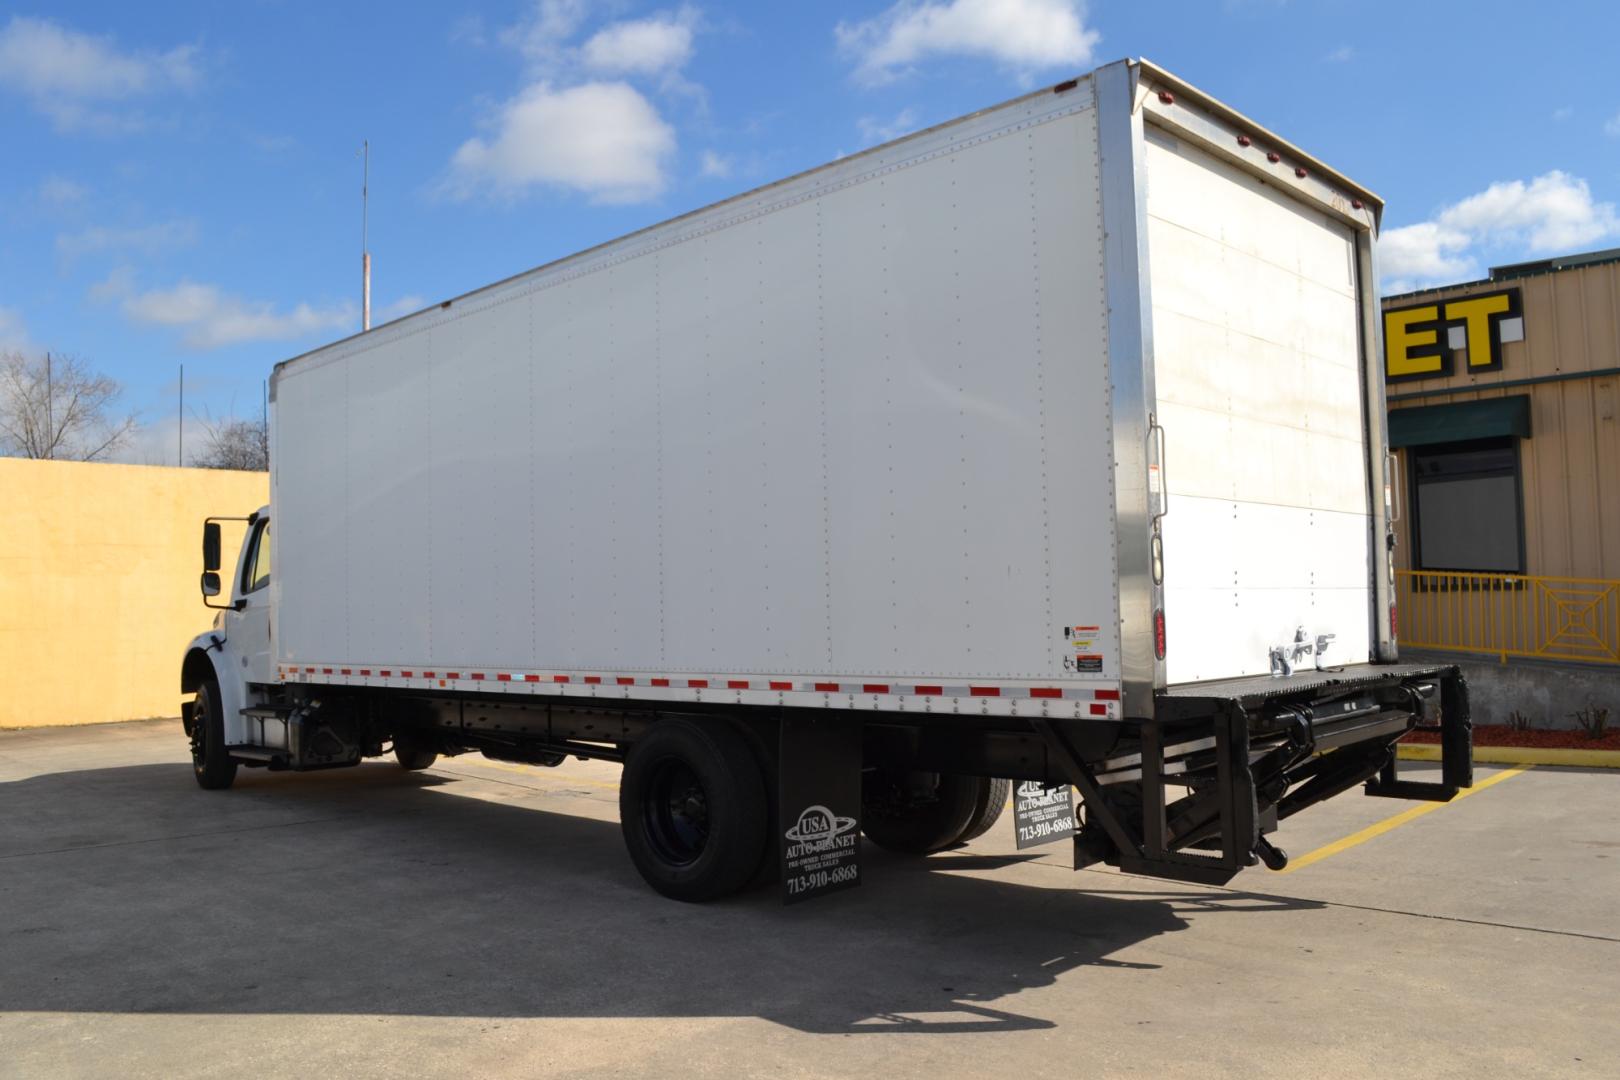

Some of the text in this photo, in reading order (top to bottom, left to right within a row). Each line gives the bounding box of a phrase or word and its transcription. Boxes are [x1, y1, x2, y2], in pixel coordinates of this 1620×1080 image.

[1383, 291, 1516, 381] ET
[802, 815, 829, 834] USA
[1019, 816, 1073, 841] 713-910-6868
[787, 864, 857, 894] 713-910-6868
